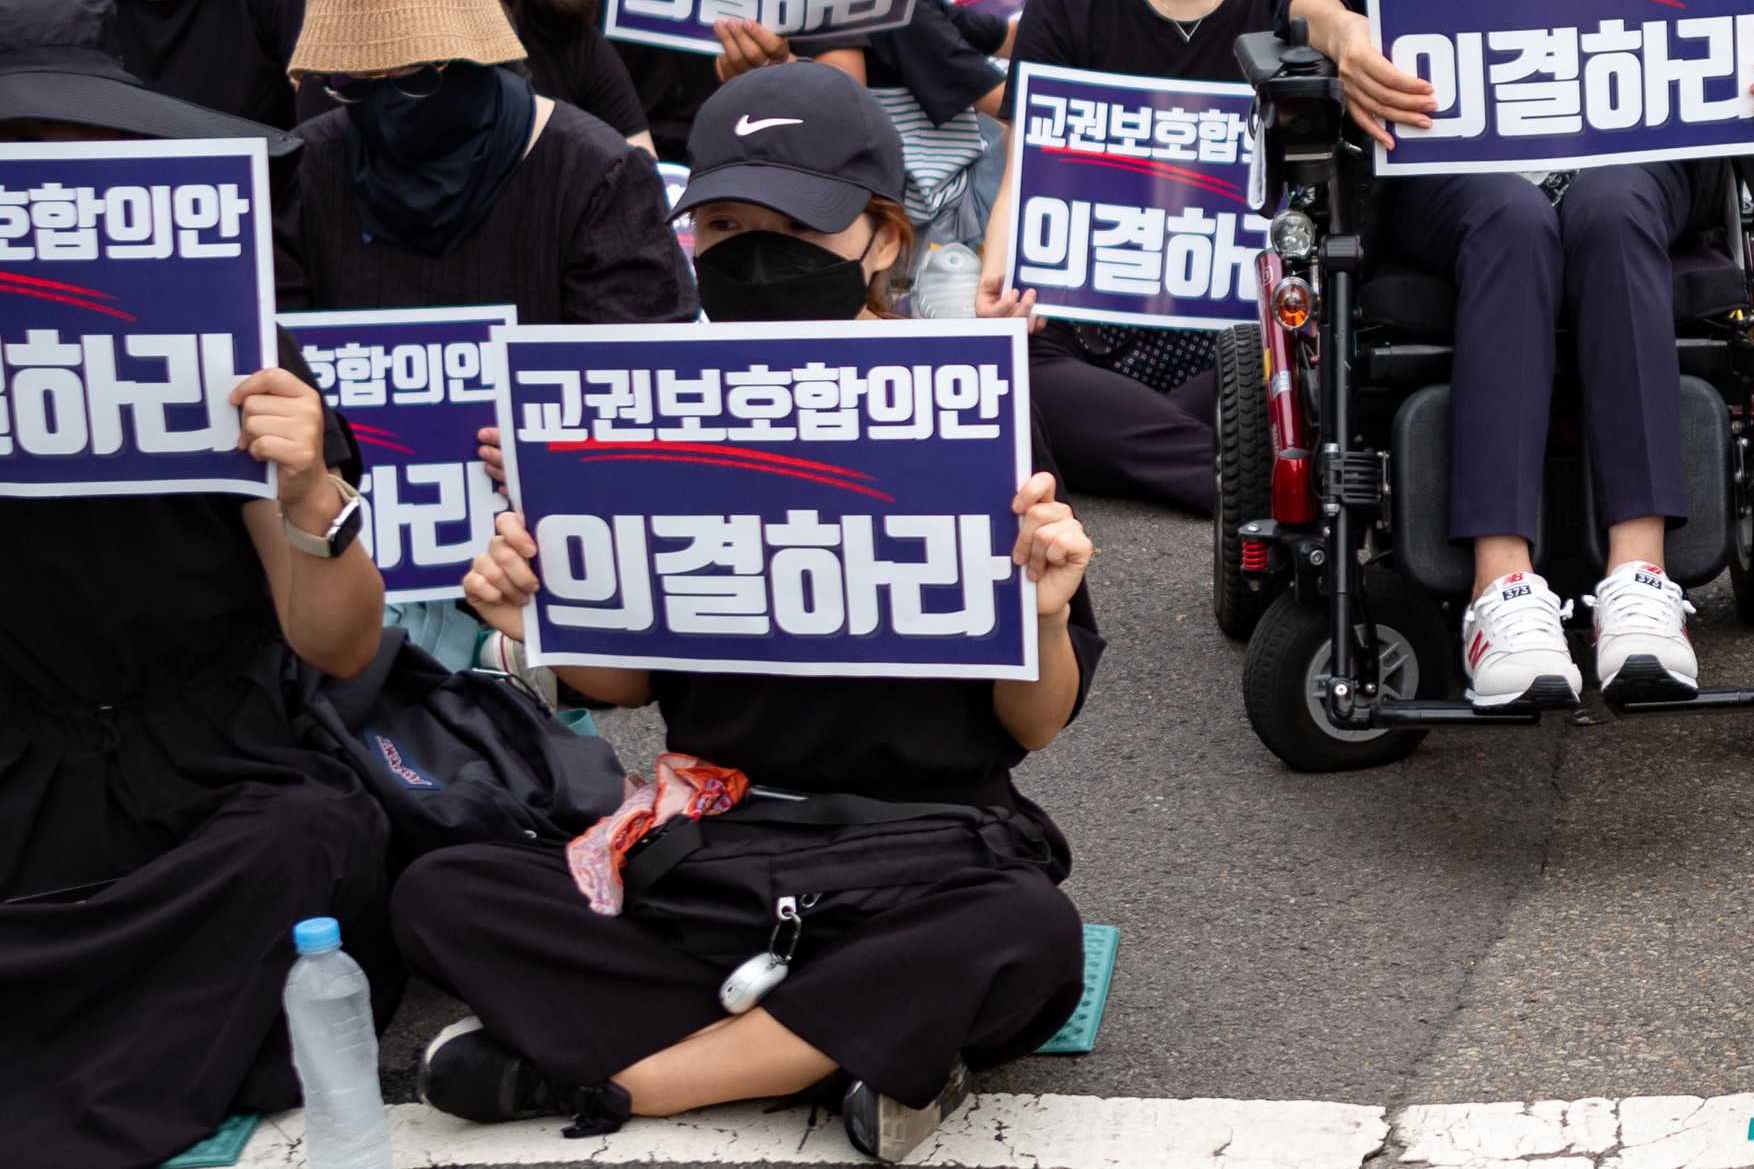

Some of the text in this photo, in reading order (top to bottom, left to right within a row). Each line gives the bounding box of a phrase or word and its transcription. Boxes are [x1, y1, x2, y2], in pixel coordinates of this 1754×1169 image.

[0, 329, 249, 455] 하라
[516, 361, 1009, 443] 교권보호합의안
[536, 509, 1012, 637] 의결하라
[1505, 587, 1530, 599] 373
[1638, 575, 1660, 588] 373
